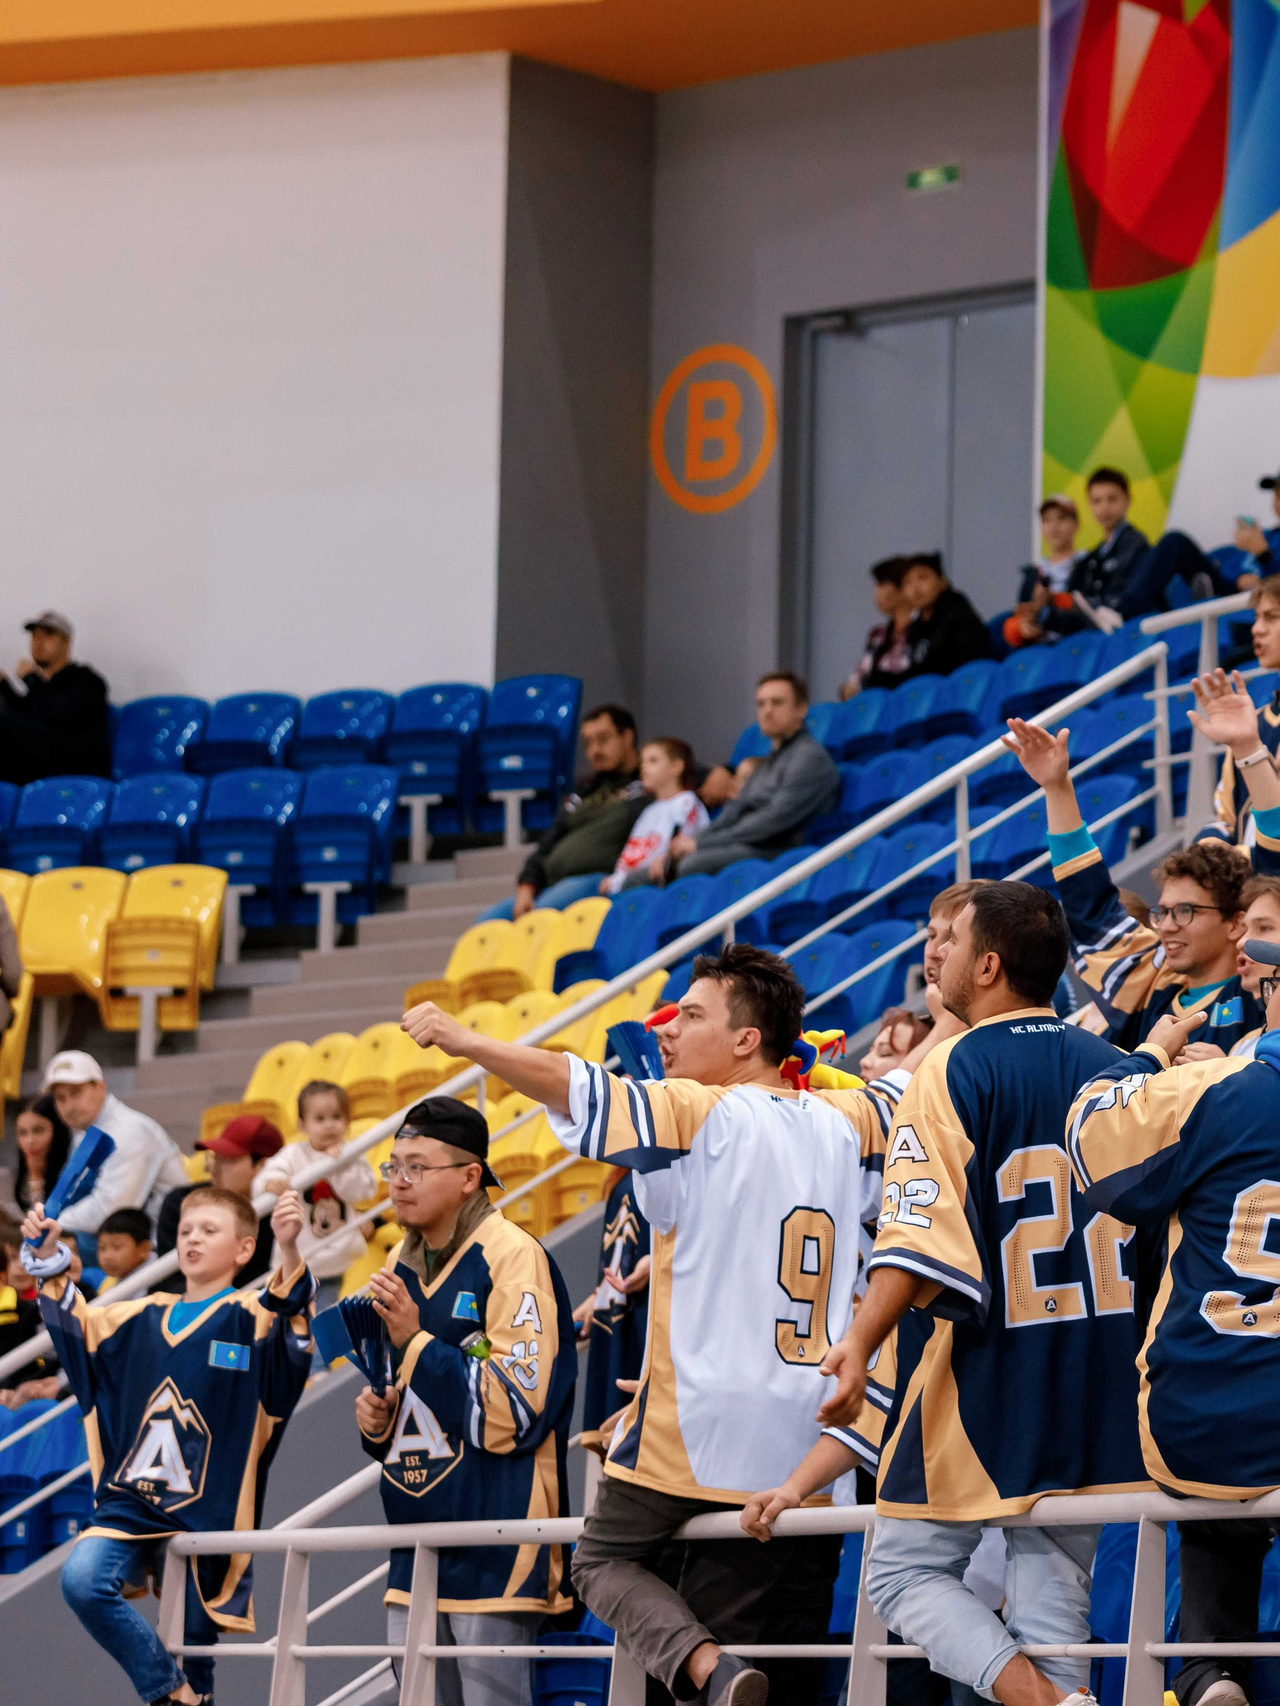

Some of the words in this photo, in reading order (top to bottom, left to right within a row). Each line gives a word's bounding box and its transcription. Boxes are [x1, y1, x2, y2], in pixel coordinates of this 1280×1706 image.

[684, 379, 743, 482] B
[887, 1124, 930, 1170] A
[511, 1291, 543, 1334] A
[775, 1205, 836, 1367] 9
[125, 1419, 194, 1493] A
[384, 1385, 455, 1465] A
[403, 1469, 428, 1484] 1957
